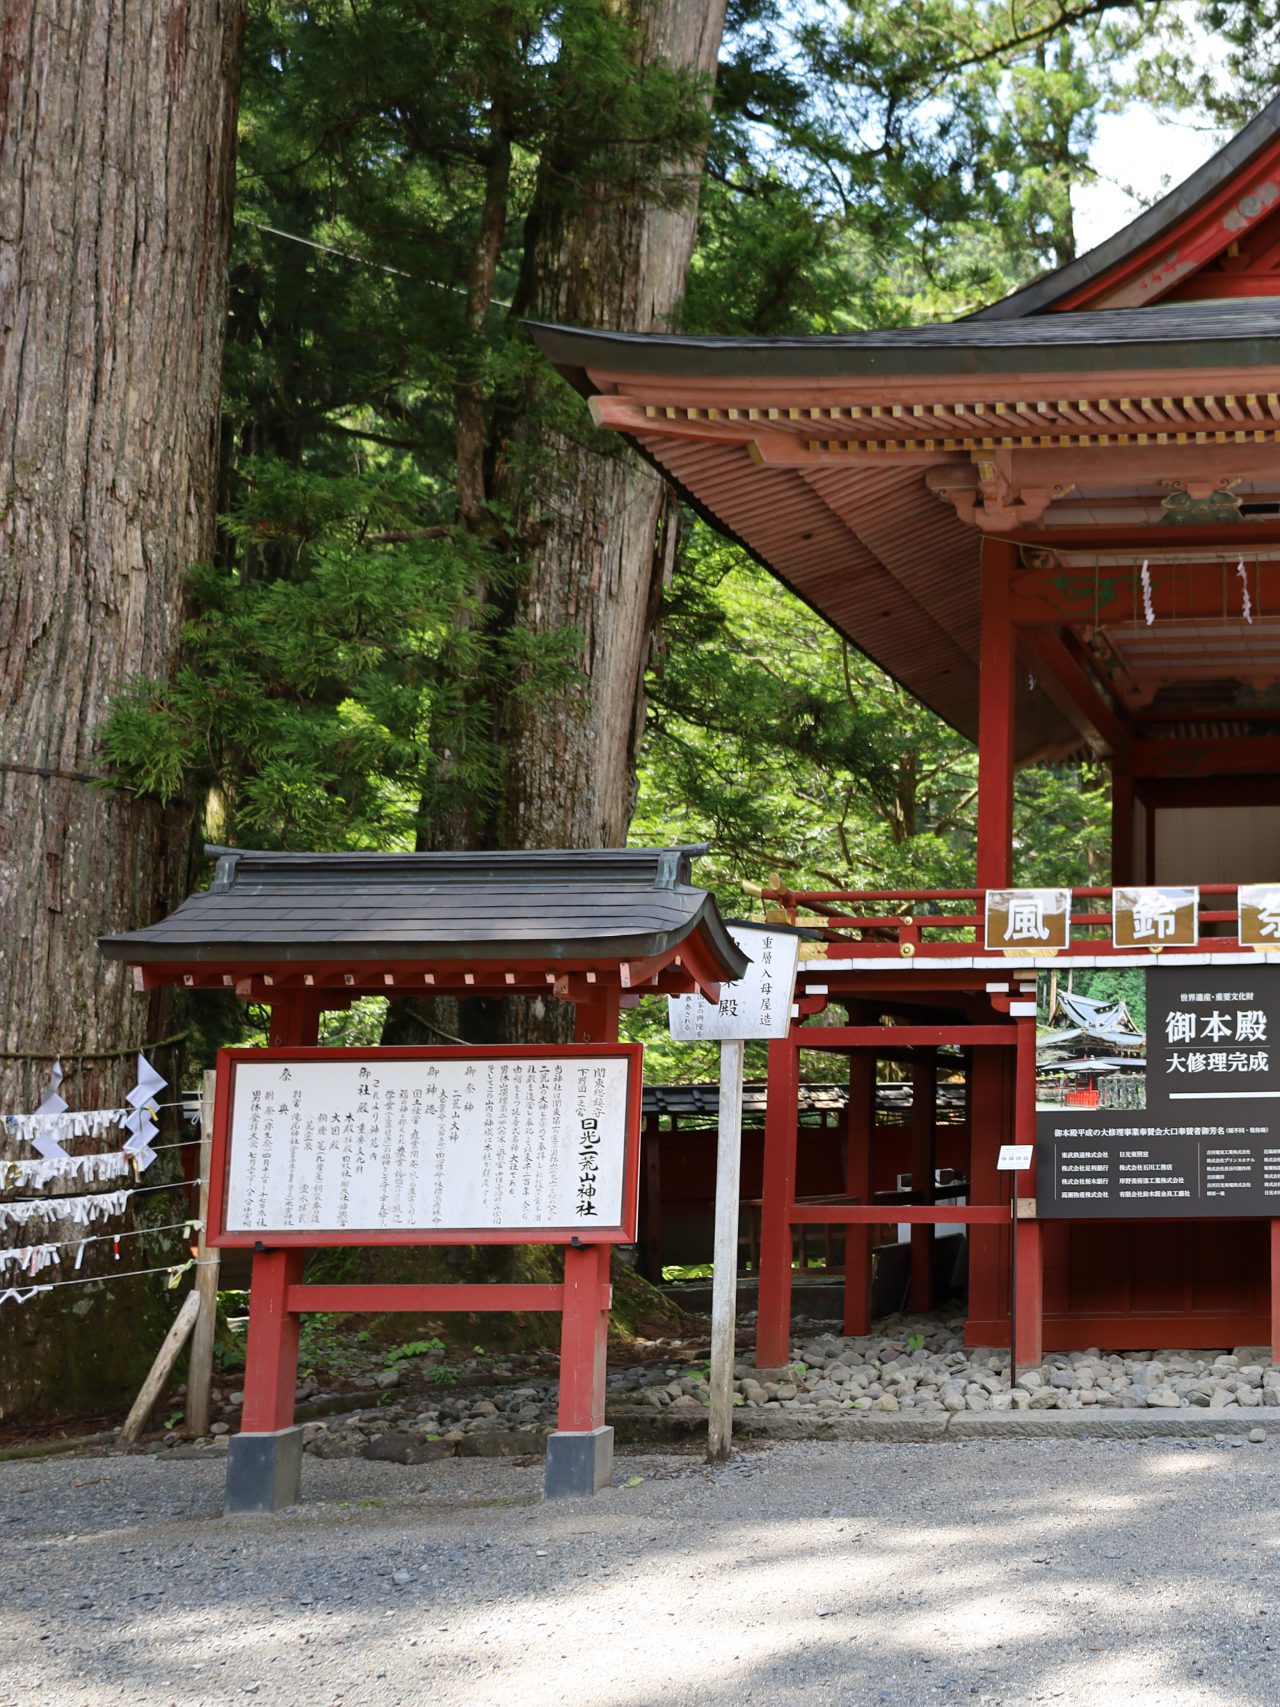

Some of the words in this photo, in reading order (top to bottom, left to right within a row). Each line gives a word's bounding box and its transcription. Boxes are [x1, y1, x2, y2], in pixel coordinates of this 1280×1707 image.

[760, 936, 774, 1026] 重層入母屋造
[1179, 992, 1255, 1002] 世界遺産・重要文化財
[1165, 1010, 1268, 1043] 御本殿
[1165, 1051, 1270, 1074] 大修理完成
[575, 1118, 601, 1217] 日光二荒山神社
